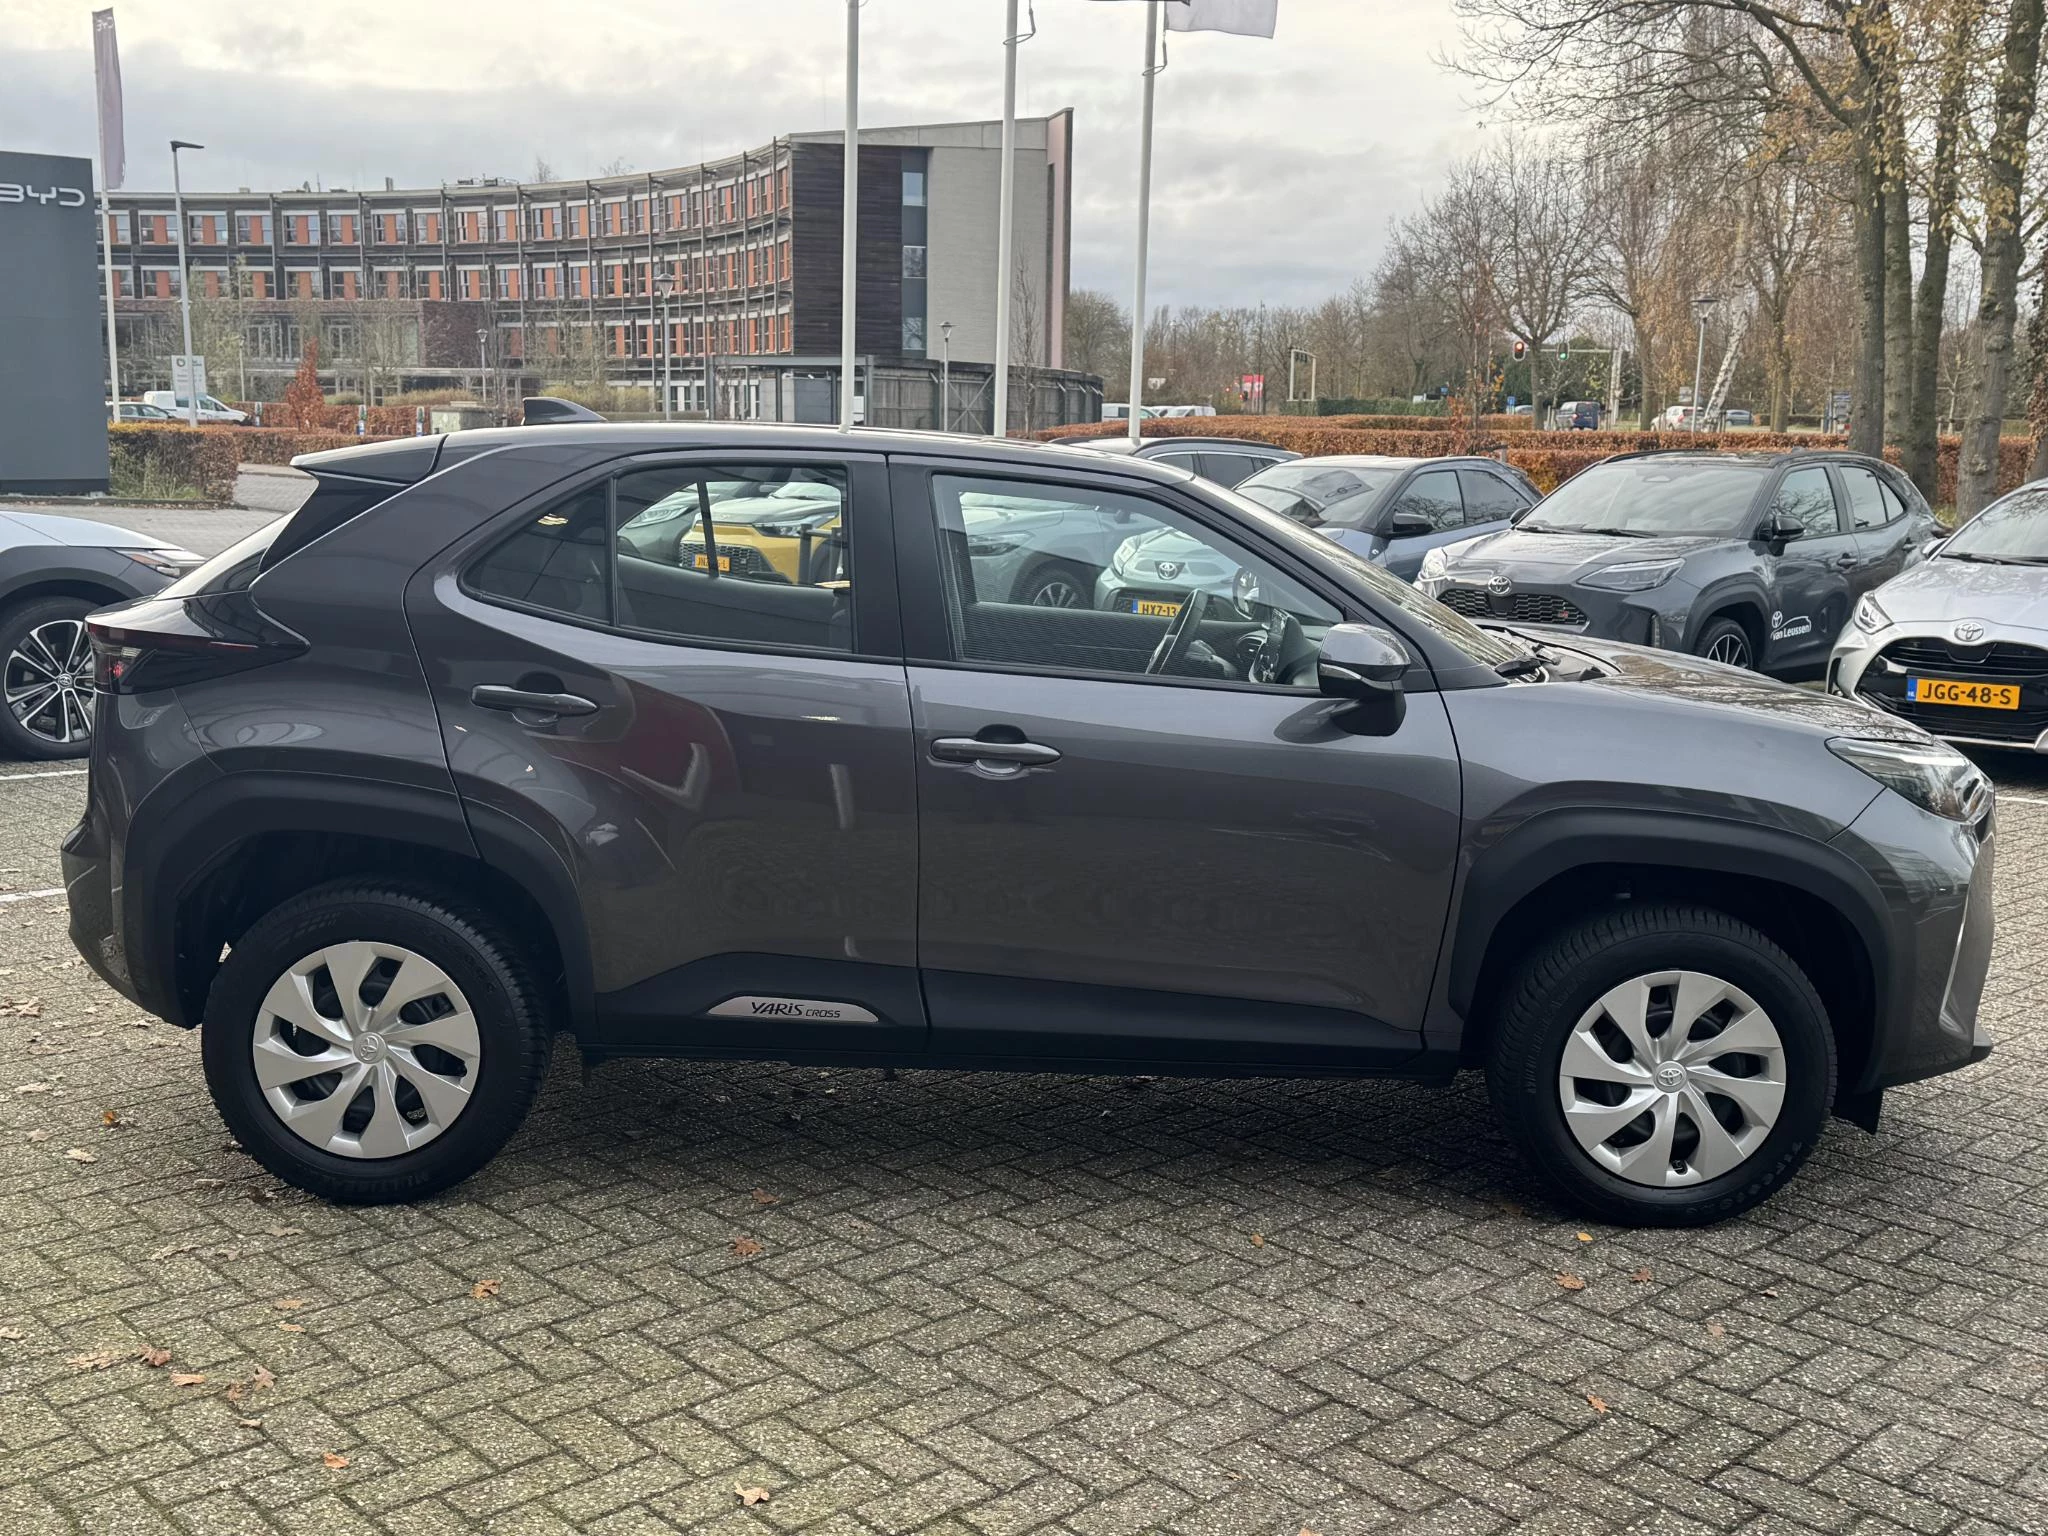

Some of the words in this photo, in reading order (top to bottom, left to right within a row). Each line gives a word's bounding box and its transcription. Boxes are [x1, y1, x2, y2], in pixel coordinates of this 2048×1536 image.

[0, 183, 86, 207] BYD
[1922, 682, 2012, 705] JGG-48-S
[805, 1009, 841, 1018] CROSS
